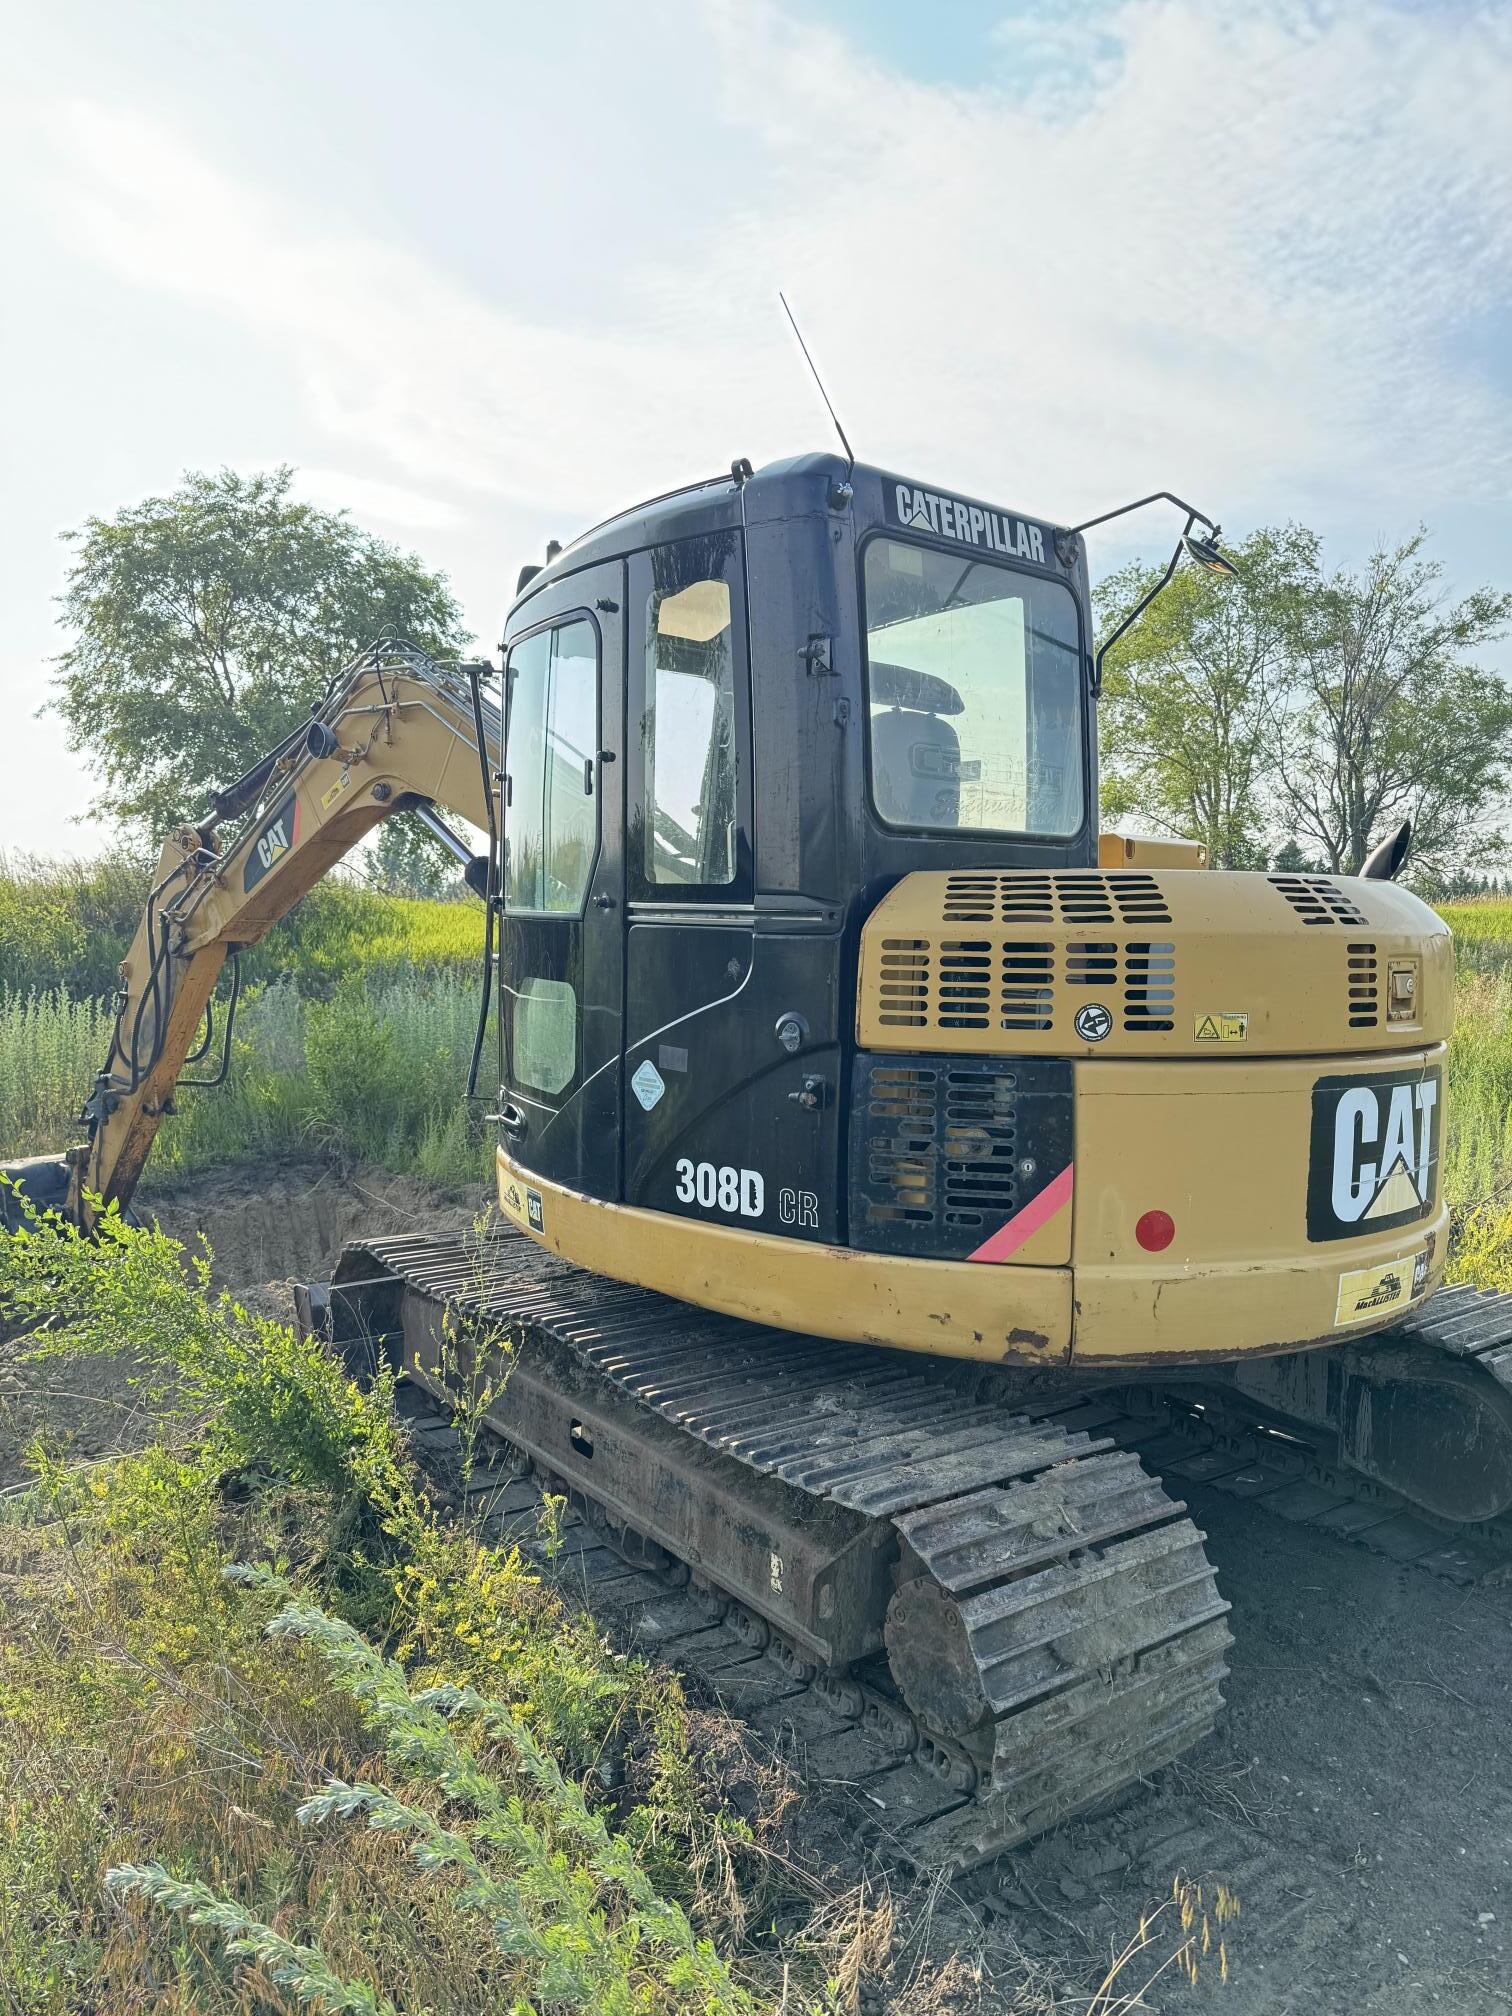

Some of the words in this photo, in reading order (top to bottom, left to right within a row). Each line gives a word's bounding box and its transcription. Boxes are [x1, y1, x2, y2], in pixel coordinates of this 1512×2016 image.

[896, 485, 1045, 563] CATERPILLAR
[257, 819, 289, 869] CAT
[1332, 1080, 1437, 1222] CAT
[676, 1159, 765, 1217] 308D
[779, 1188, 819, 1228] CR
